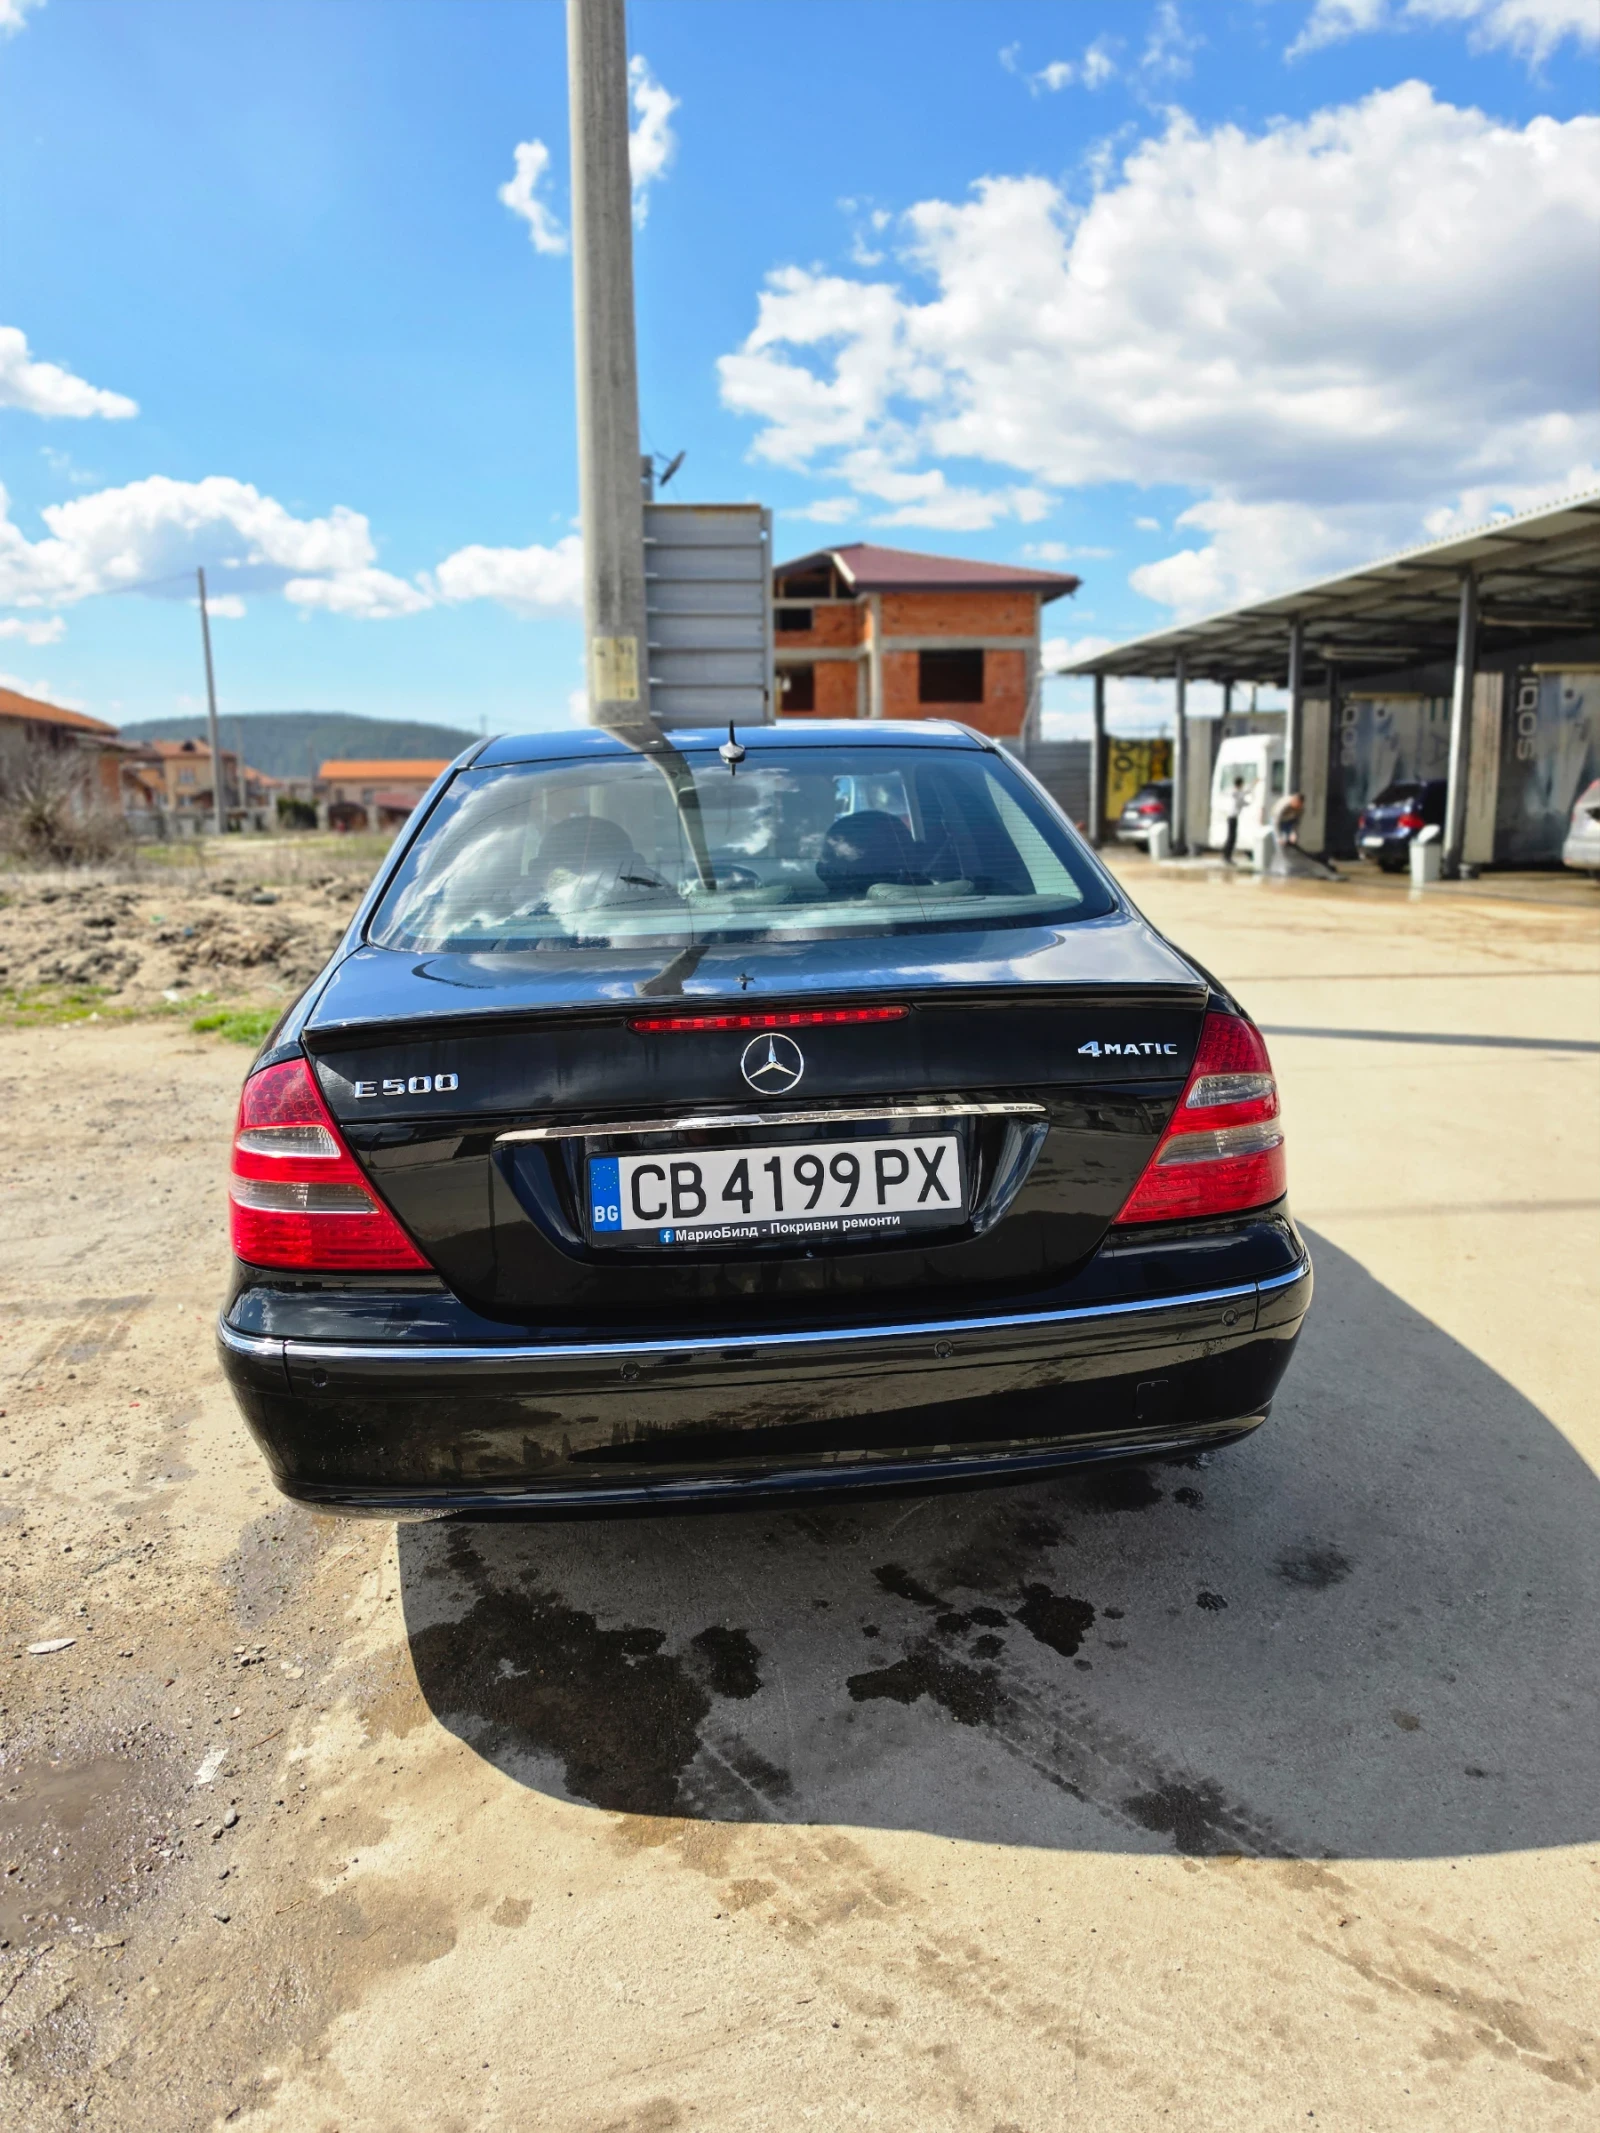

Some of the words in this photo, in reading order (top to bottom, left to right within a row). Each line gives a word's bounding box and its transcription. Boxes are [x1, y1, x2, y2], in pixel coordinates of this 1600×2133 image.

[1078, 1041, 1178, 1057] 4MATIC
[631, 1162, 706, 1220] CB
[722, 1152, 860, 1214] 4199
[594, 1205, 619, 1222] BG
[676, 1226, 758, 1242] МариоБилд
[771, 1221, 838, 1234] Покривни
[843, 1216, 900, 1231] ремонти
